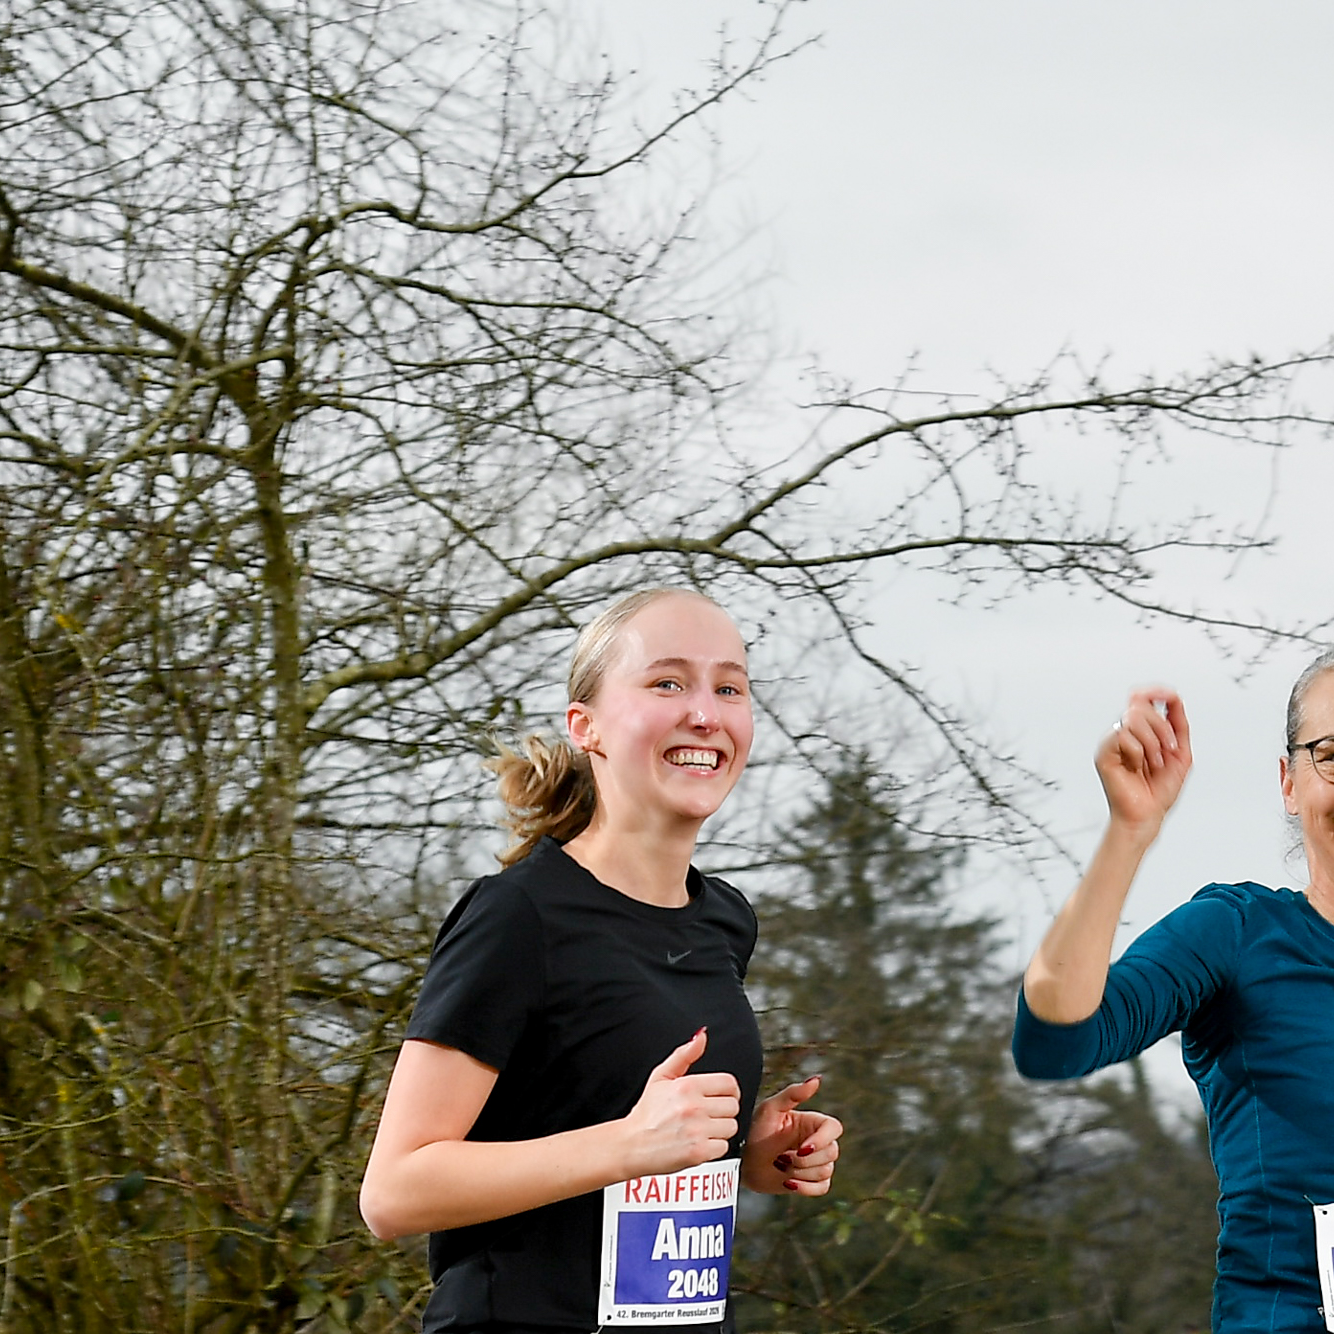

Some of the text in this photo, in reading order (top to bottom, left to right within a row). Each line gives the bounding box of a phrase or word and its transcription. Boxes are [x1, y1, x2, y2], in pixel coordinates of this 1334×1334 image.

[625, 1171, 733, 1203] RAIFFEISEN
[651, 1217, 725, 1261] Anna
[667, 1267, 719, 1299] 2048
[616, 1310, 629, 1319] 42.
[631, 1309, 675, 1320] Bremgarter
[677, 1307, 708, 1318] Reusslauf
